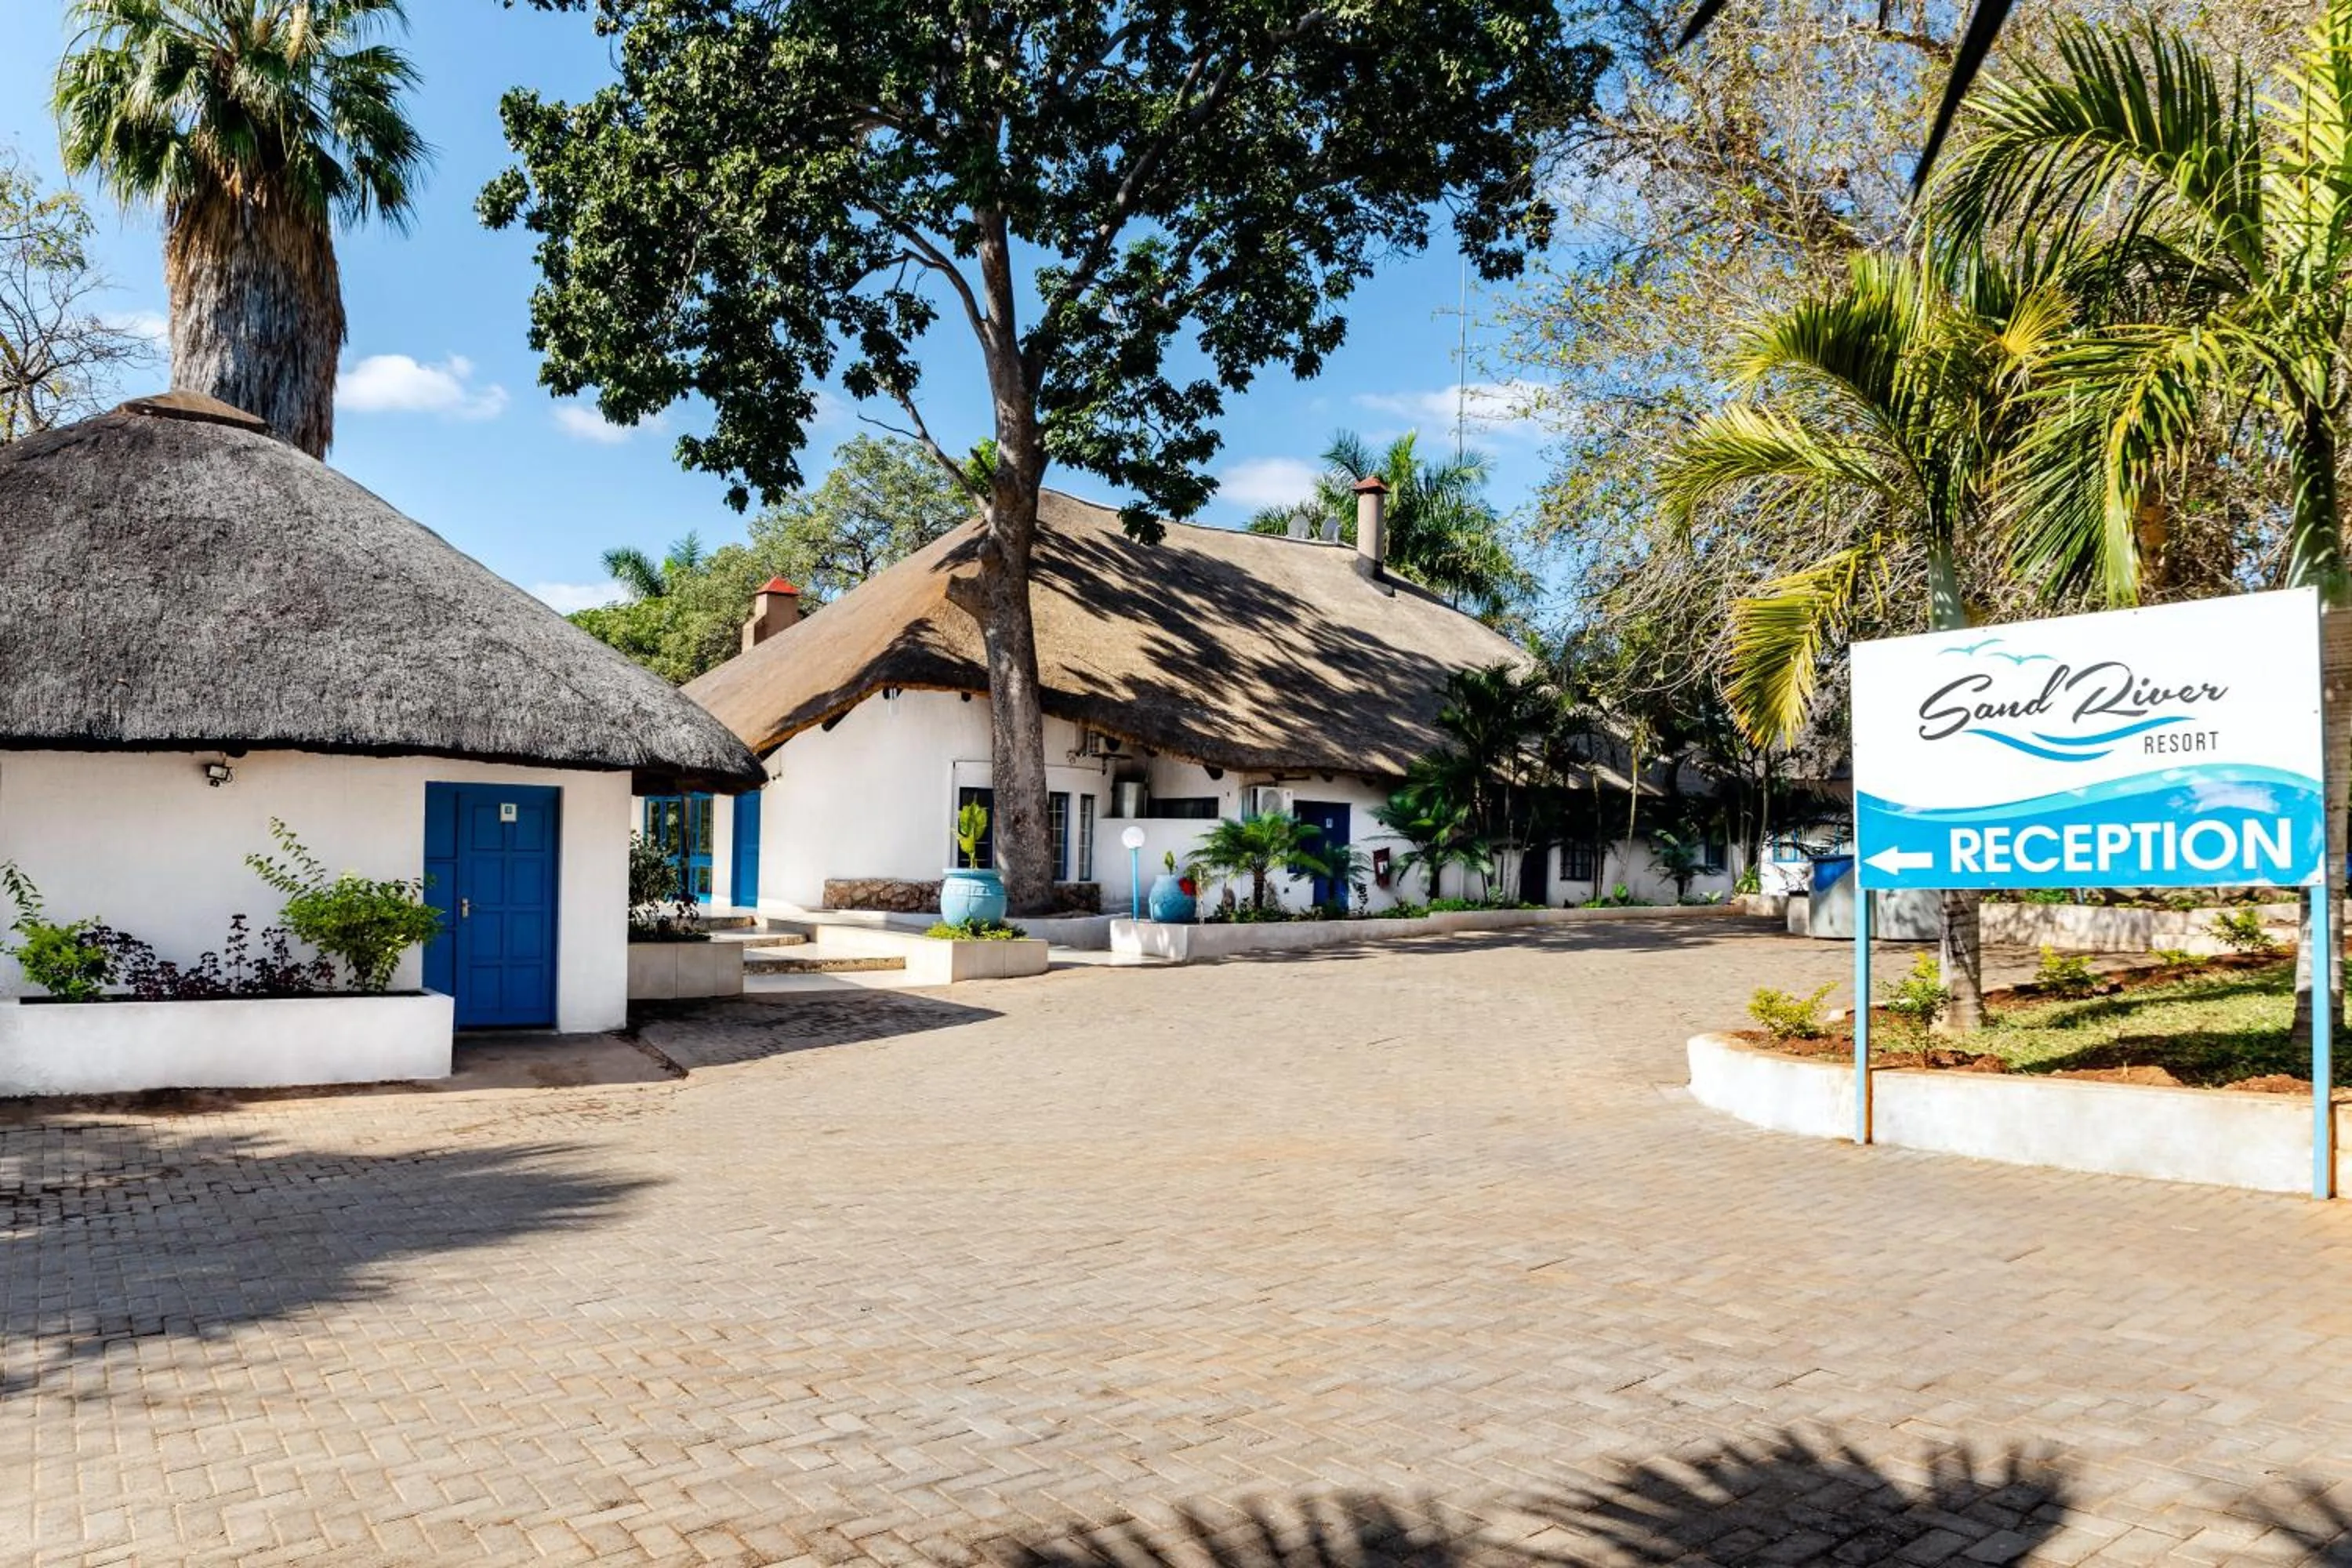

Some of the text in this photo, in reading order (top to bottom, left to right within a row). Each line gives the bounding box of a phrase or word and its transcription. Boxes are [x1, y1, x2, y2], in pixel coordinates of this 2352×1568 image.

[1918, 661, 2229, 741] Sand River
[2143, 731, 2220, 754] RESORT
[1950, 818, 2292, 873] RECEPTION
